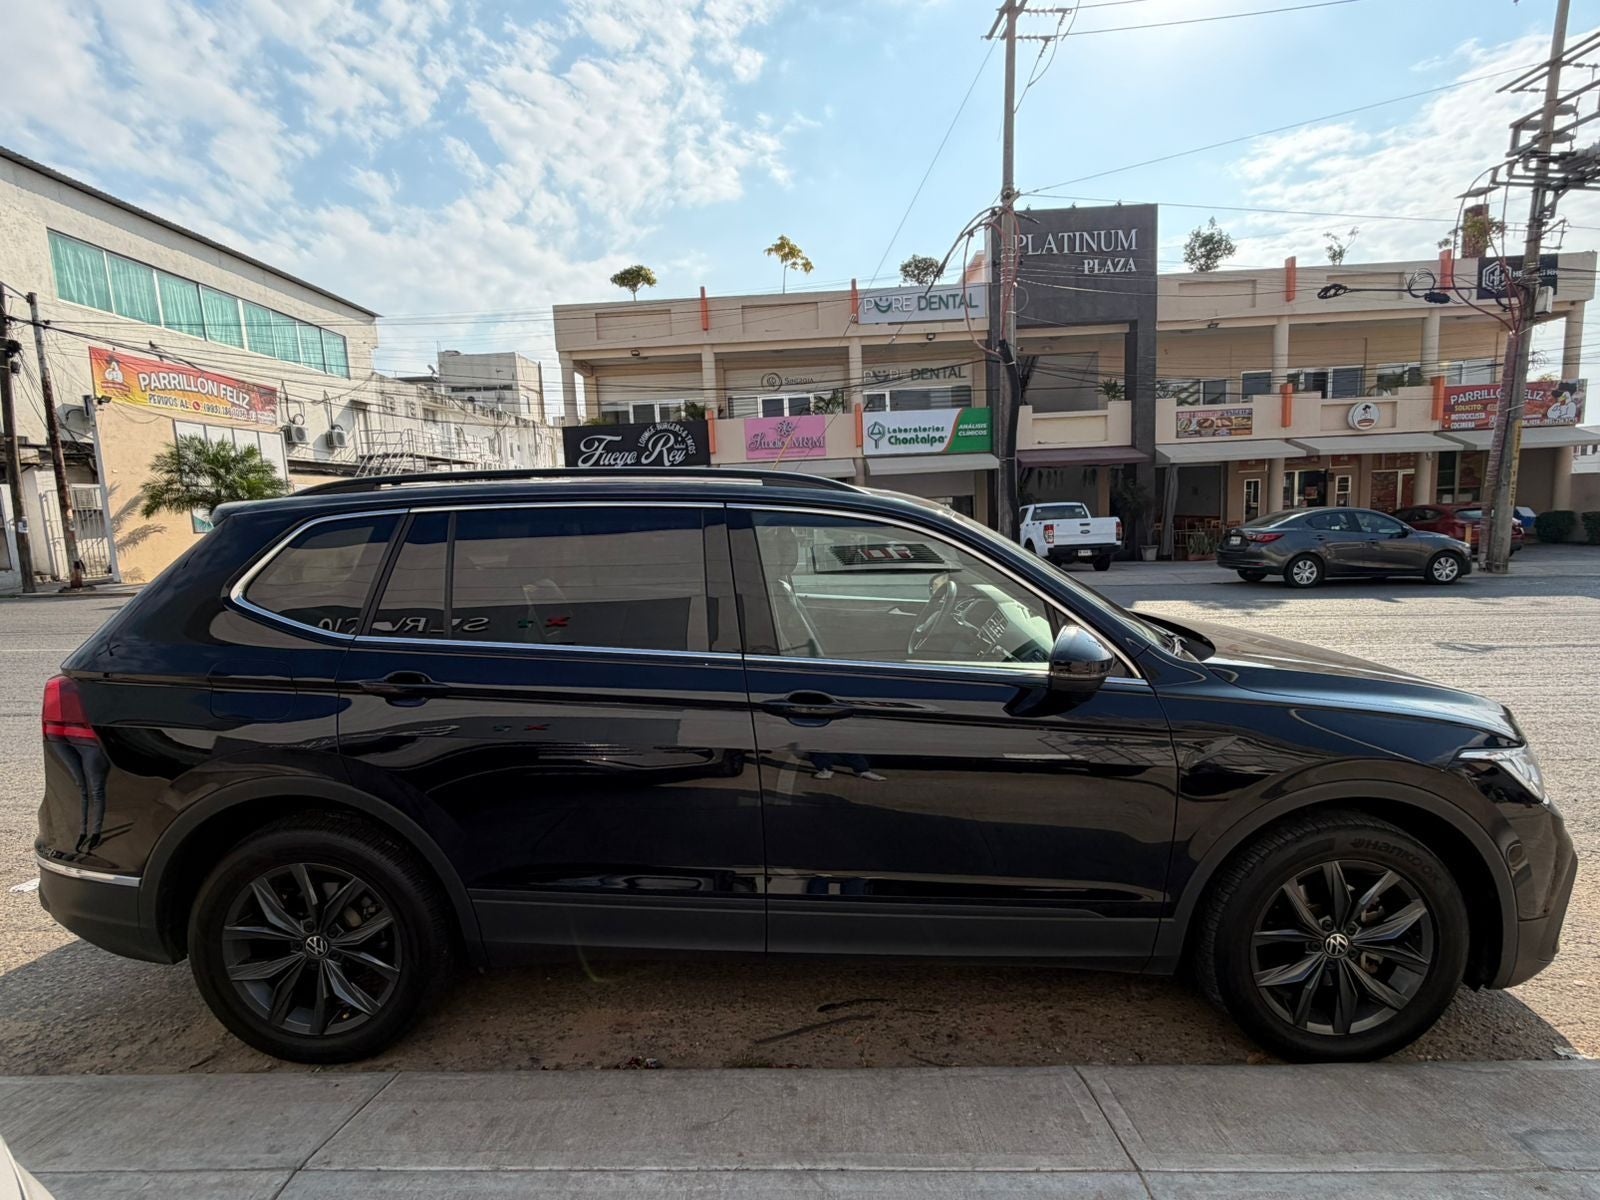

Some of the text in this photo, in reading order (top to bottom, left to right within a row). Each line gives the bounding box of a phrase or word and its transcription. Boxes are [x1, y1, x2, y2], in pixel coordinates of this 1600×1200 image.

[1013, 228, 1138, 256] PLATINUM
[1083, 257, 1137, 275] PLAZA
[917, 292, 979, 312] DENTAL
[911, 366, 967, 381] DENTAL
[220, 383, 250, 410] FELIZ
[1450, 388, 1544, 405] PARRILLO ELIZ
[887, 424, 945, 434] Laboratorios
[888, 433, 945, 447] Chontalpa
[577, 432, 687, 467] Fuego Rey
